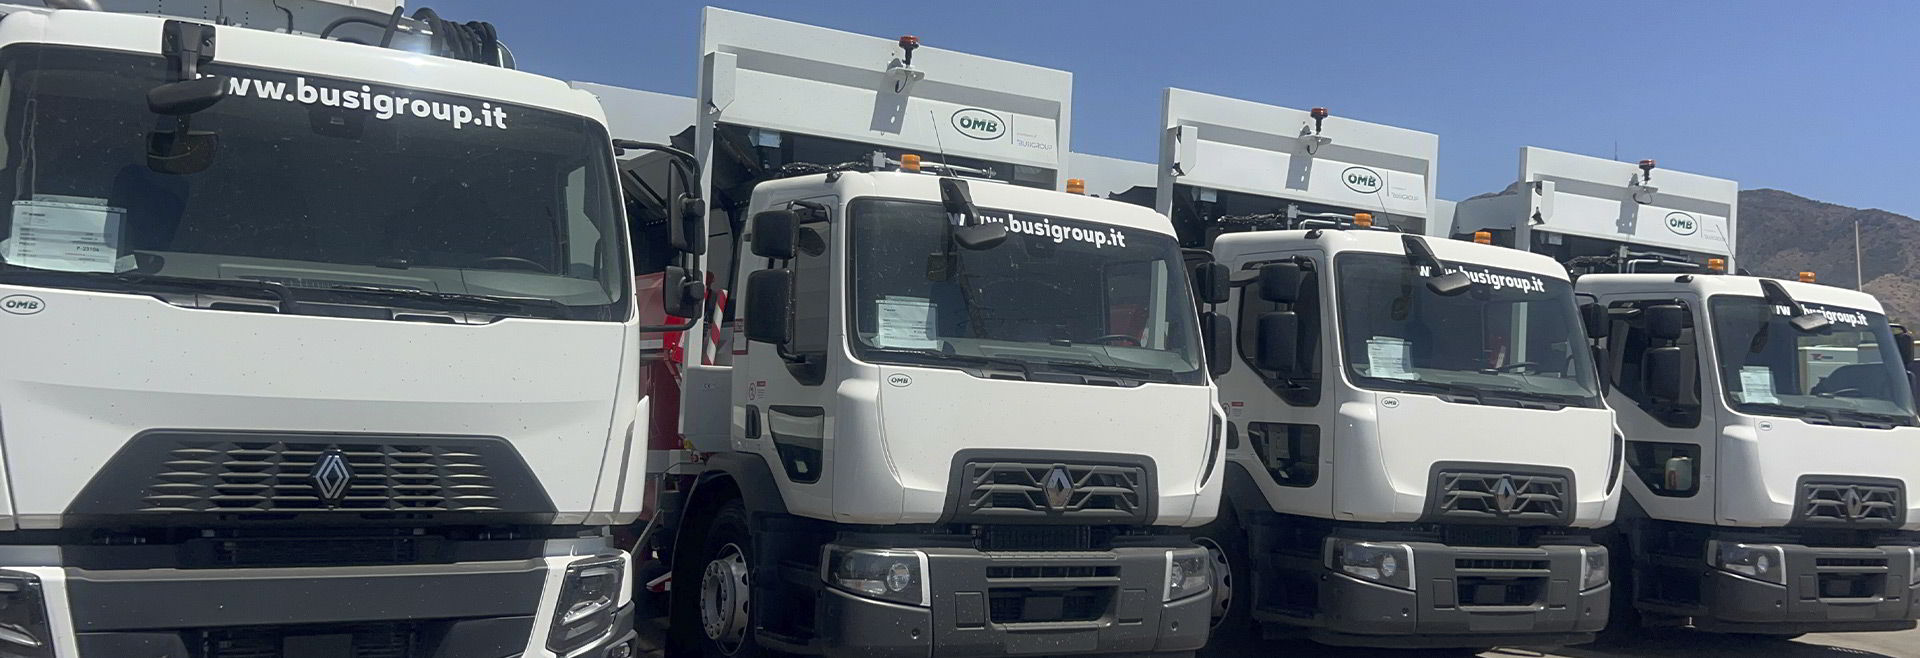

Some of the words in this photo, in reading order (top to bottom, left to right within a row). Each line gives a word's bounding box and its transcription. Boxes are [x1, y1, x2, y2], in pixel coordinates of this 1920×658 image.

[196, 73, 508, 129] ww.busigroup.it
[960, 116, 998, 133] OMB
[1348, 173, 1377, 187] OMB
[948, 212, 1126, 248] w.busigroup.it
[1669, 218, 1693, 230] OMB
[6, 300, 39, 310] OMB
[891, 376, 909, 384] OMB
